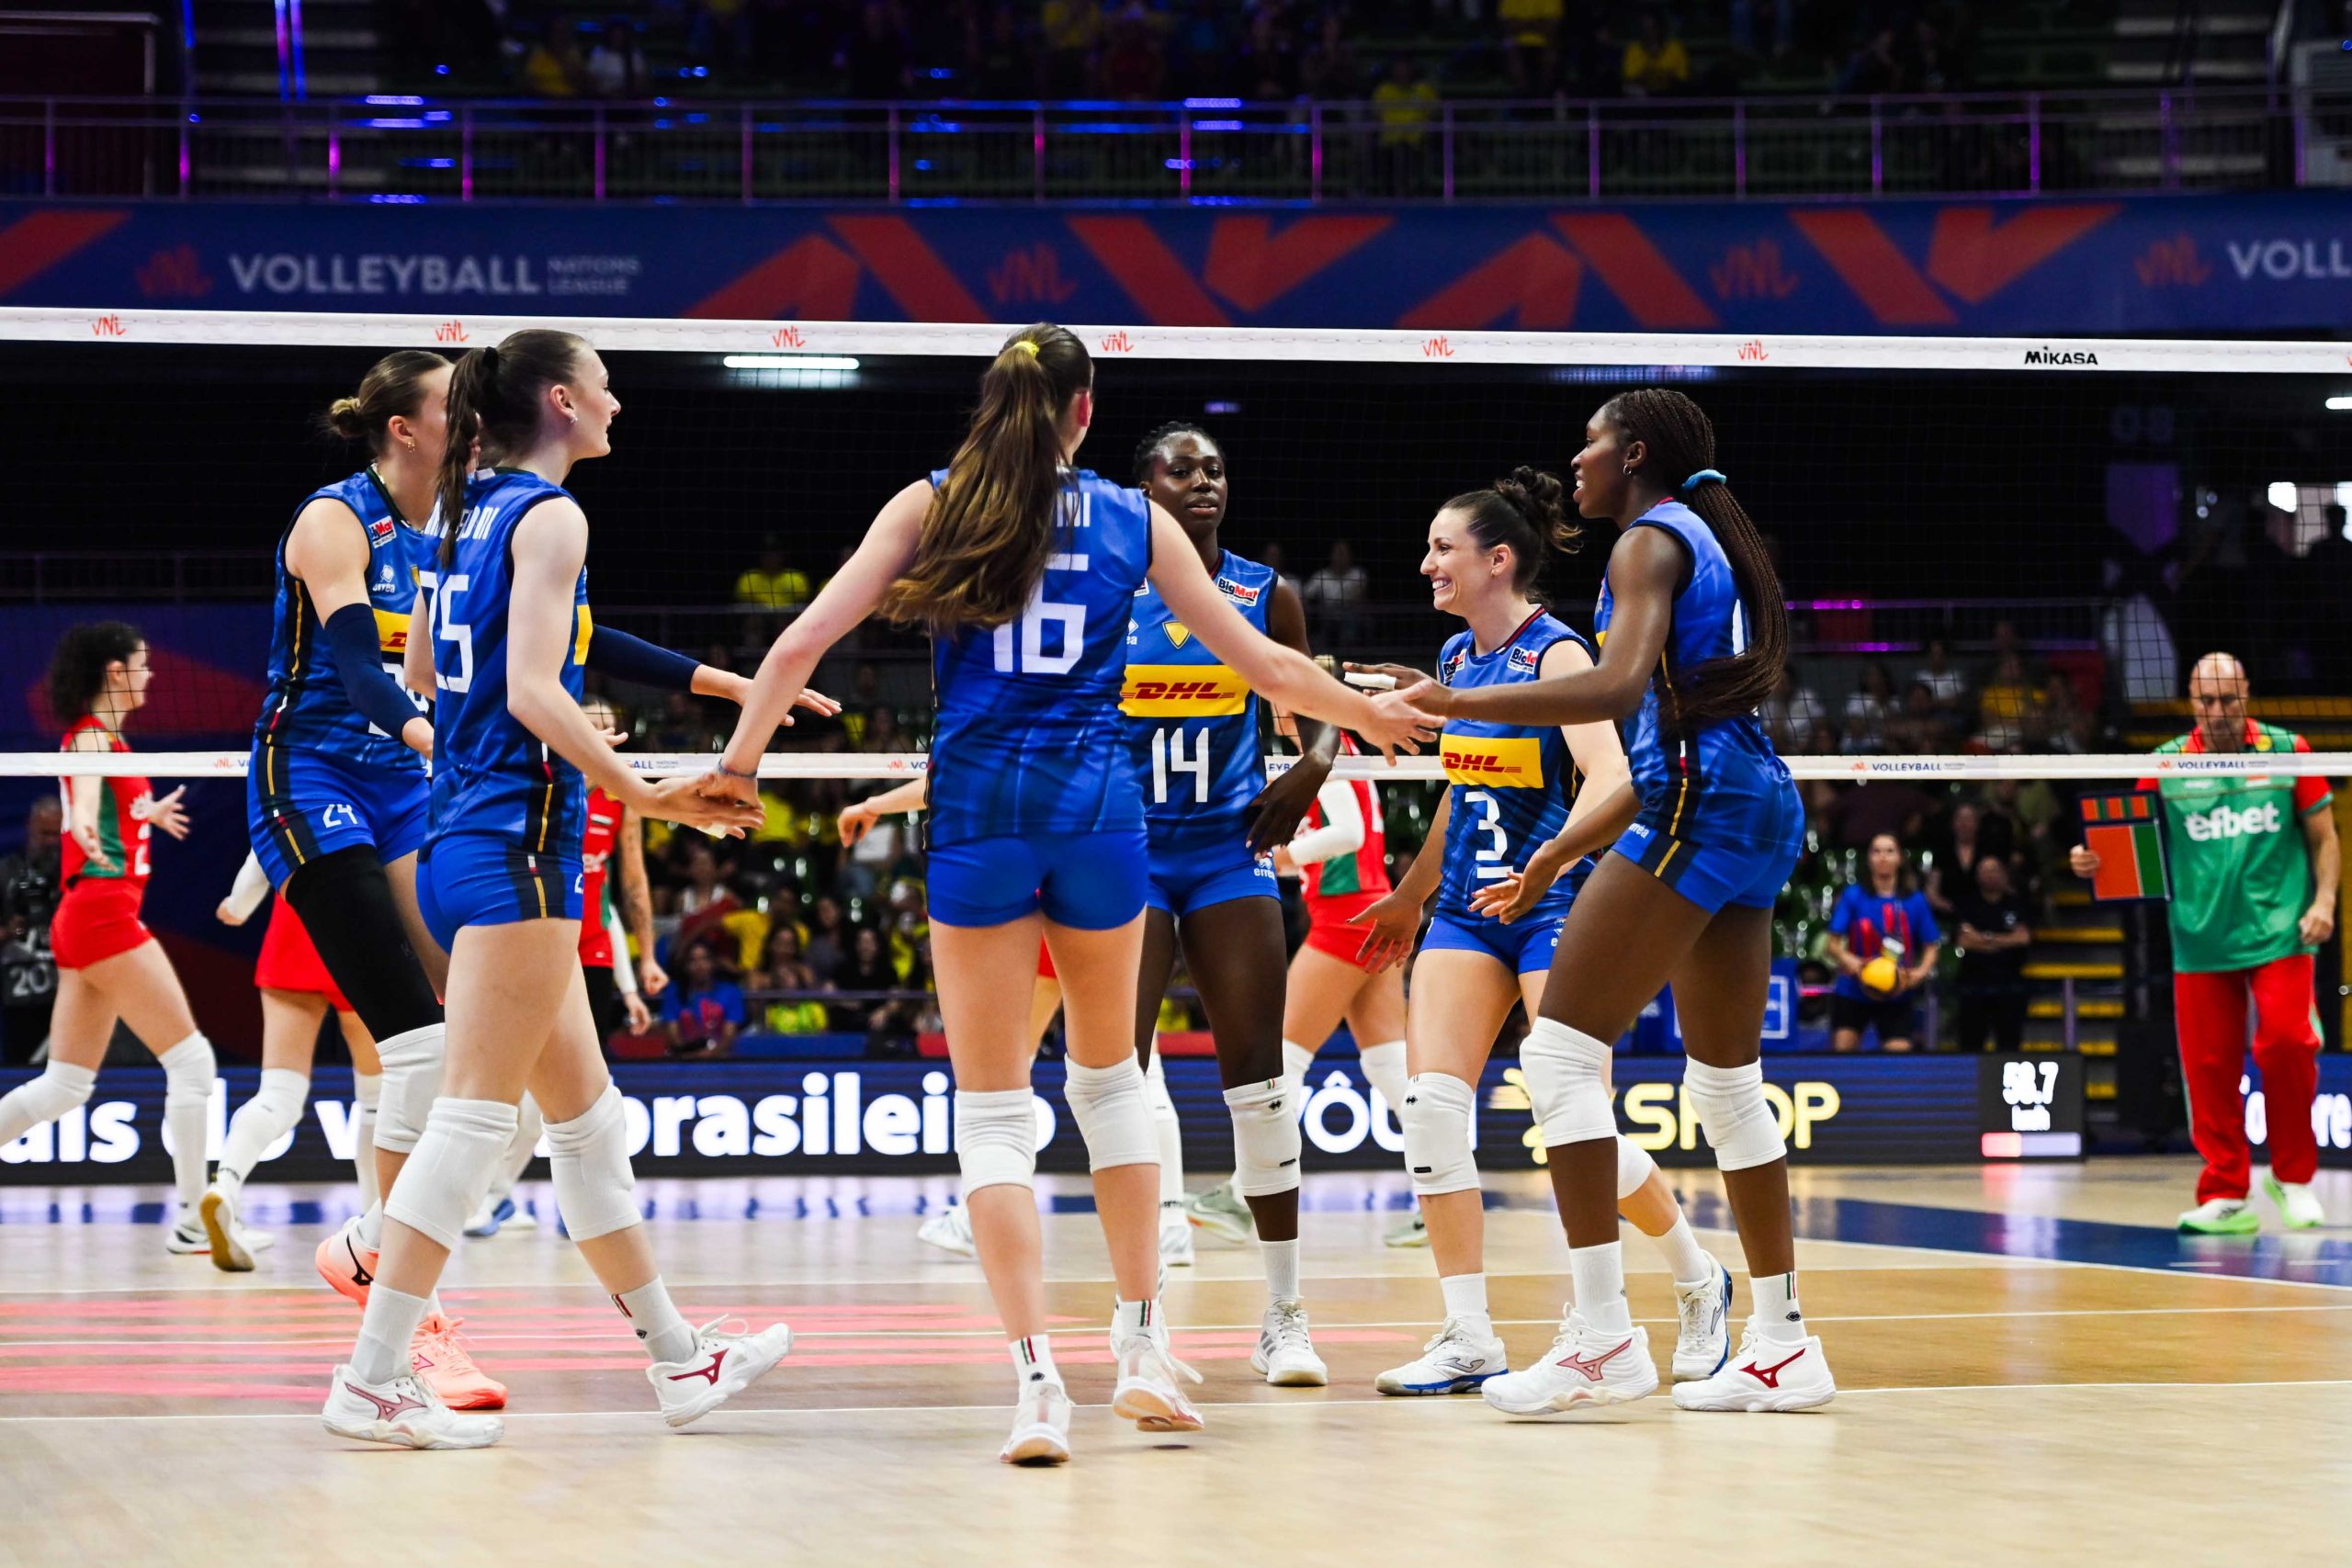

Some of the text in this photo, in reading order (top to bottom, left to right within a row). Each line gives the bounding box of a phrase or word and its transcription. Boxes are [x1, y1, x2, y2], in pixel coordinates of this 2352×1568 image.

[229, 254, 540, 294] VOLLEYBALL
[548, 256, 641, 275] NATIONS
[548, 277, 629, 296] LEAGUE
[1218, 578, 1258, 599] BigMat
[1135, 682, 1221, 700] DHL
[1152, 728, 1209, 804] 14
[1443, 752, 1505, 773] DHL
[1871, 762, 1942, 772] VOLLEYBALL
[2177, 761, 2246, 770] VOLLEYBALL
[323, 803, 359, 829] 24
[1464, 791, 1508, 861] 3
[2184, 801, 2281, 841] efbet
[610, 1072, 1056, 1156] rasilei
